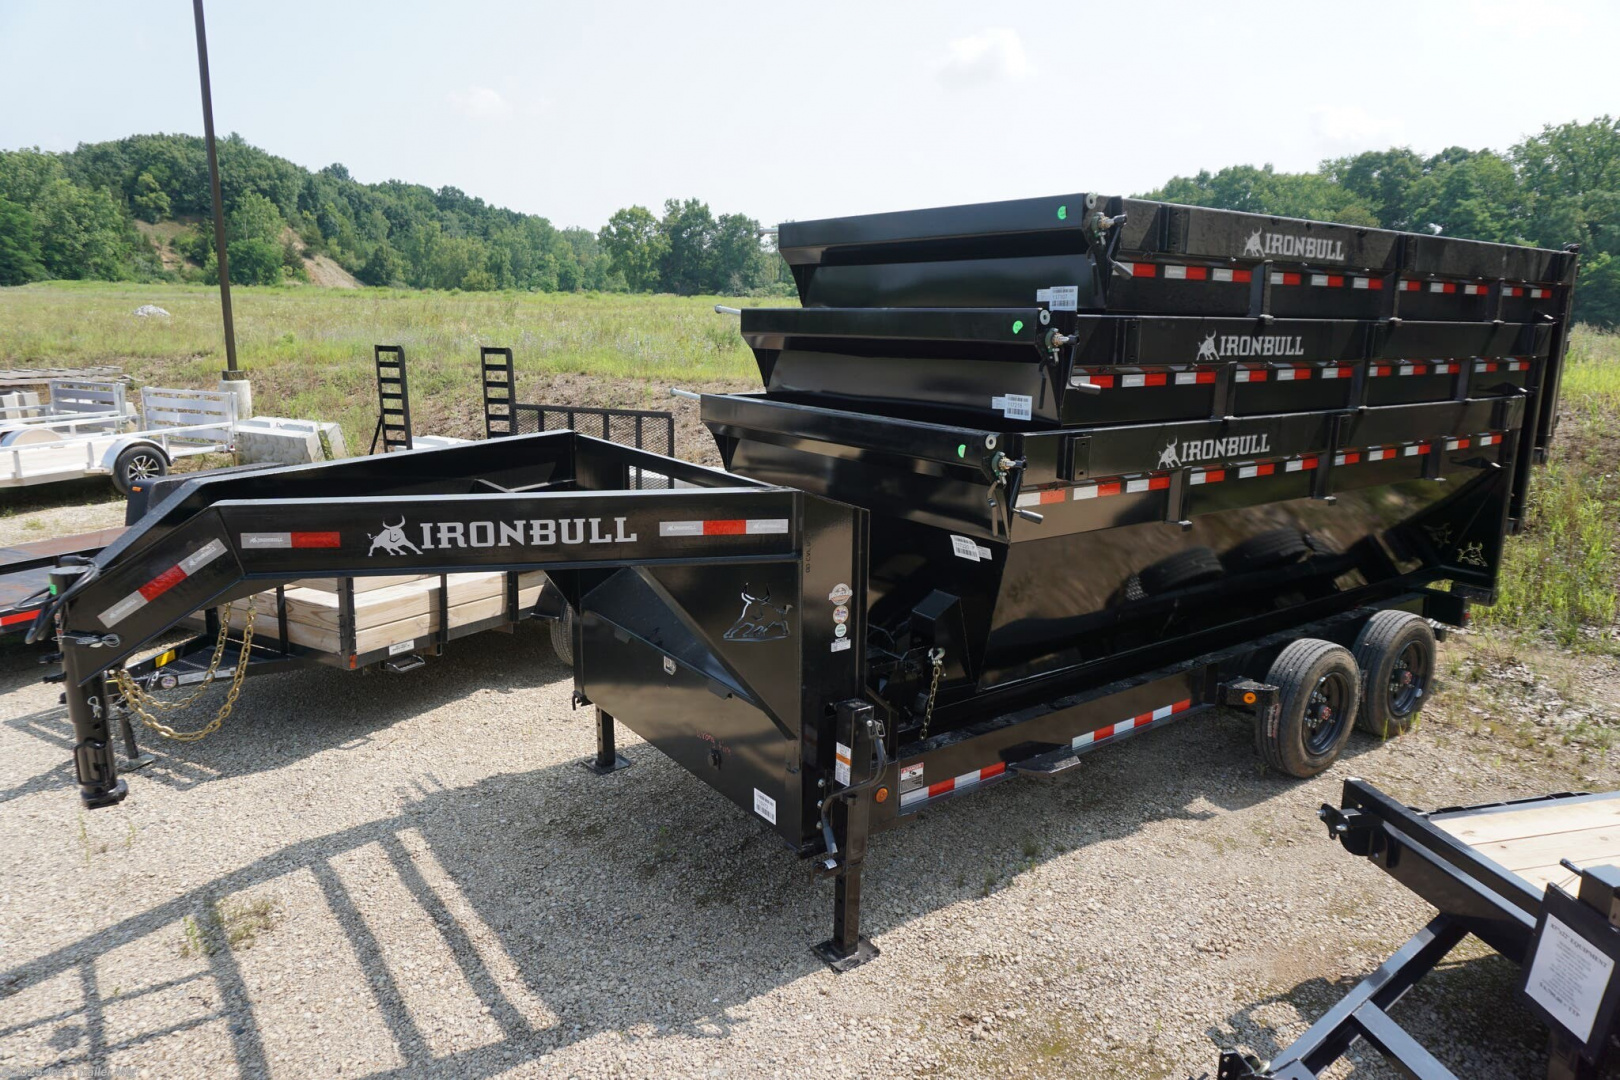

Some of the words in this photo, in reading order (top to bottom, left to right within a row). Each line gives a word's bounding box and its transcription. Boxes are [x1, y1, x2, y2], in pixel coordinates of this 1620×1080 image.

[1264, 233, 1344, 260] IRONBULL
[1219, 336, 1304, 356] IRONBULL
[1181, 434, 1270, 462] IRONBULL
[420, 517, 637, 549] IRONBULL
[1570, 938, 1608, 968] EQUIPMENT
